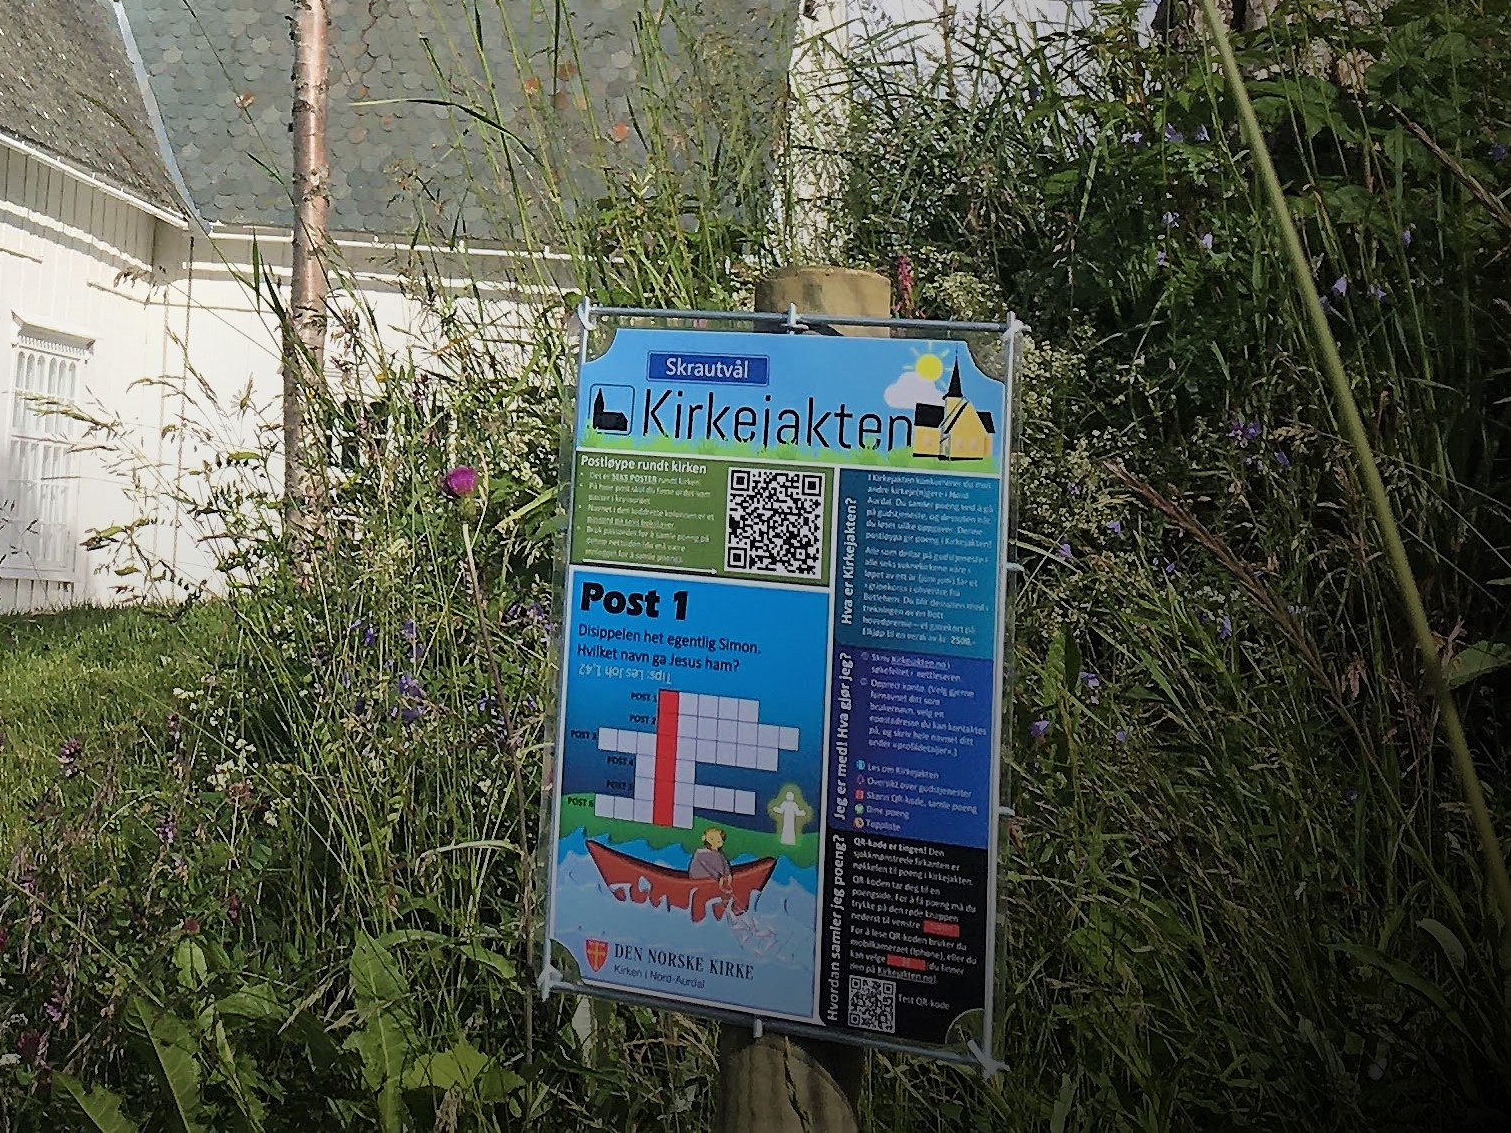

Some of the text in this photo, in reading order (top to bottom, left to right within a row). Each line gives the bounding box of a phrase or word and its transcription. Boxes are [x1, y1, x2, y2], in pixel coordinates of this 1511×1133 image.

[665, 357, 749, 379] Skrautvål
[643, 388, 912, 452] Kirkejakten
[581, 454, 706, 474] Postløype rundt kirken
[841, 497, 858, 624] Hva er Kirkejakten?
[580, 582, 689, 620] Post 1
[579, 623, 761, 654] Disippelen het egentlig Simon.
[577, 644, 740, 672] Hvilket navn ga Jesus ham?
[579, 663, 672, 685] Tips: Les Joh 1,42
[631, 691, 651, 702] POST
[629, 714, 651, 724] POST
[570, 729, 590, 739] POST
[833, 652, 853, 820] Jeg er med! Hva gjør jeg?
[607, 755, 626, 766] POST
[606, 779, 625, 789] POST
[567, 796, 587, 806] POST
[928, 846, 944, 856] Den
[898, 869, 922, 879] poeng
[888, 904, 903, 914] den
[925, 899, 949, 910] poeng
[826, 834, 847, 1020] Hvordan samler jeg poeng?
[614, 943, 754, 981] DEN NORSKE KIRKE
[614, 964, 643, 979] Kirken
[650, 970, 705, 989] Nord-Aurdal
